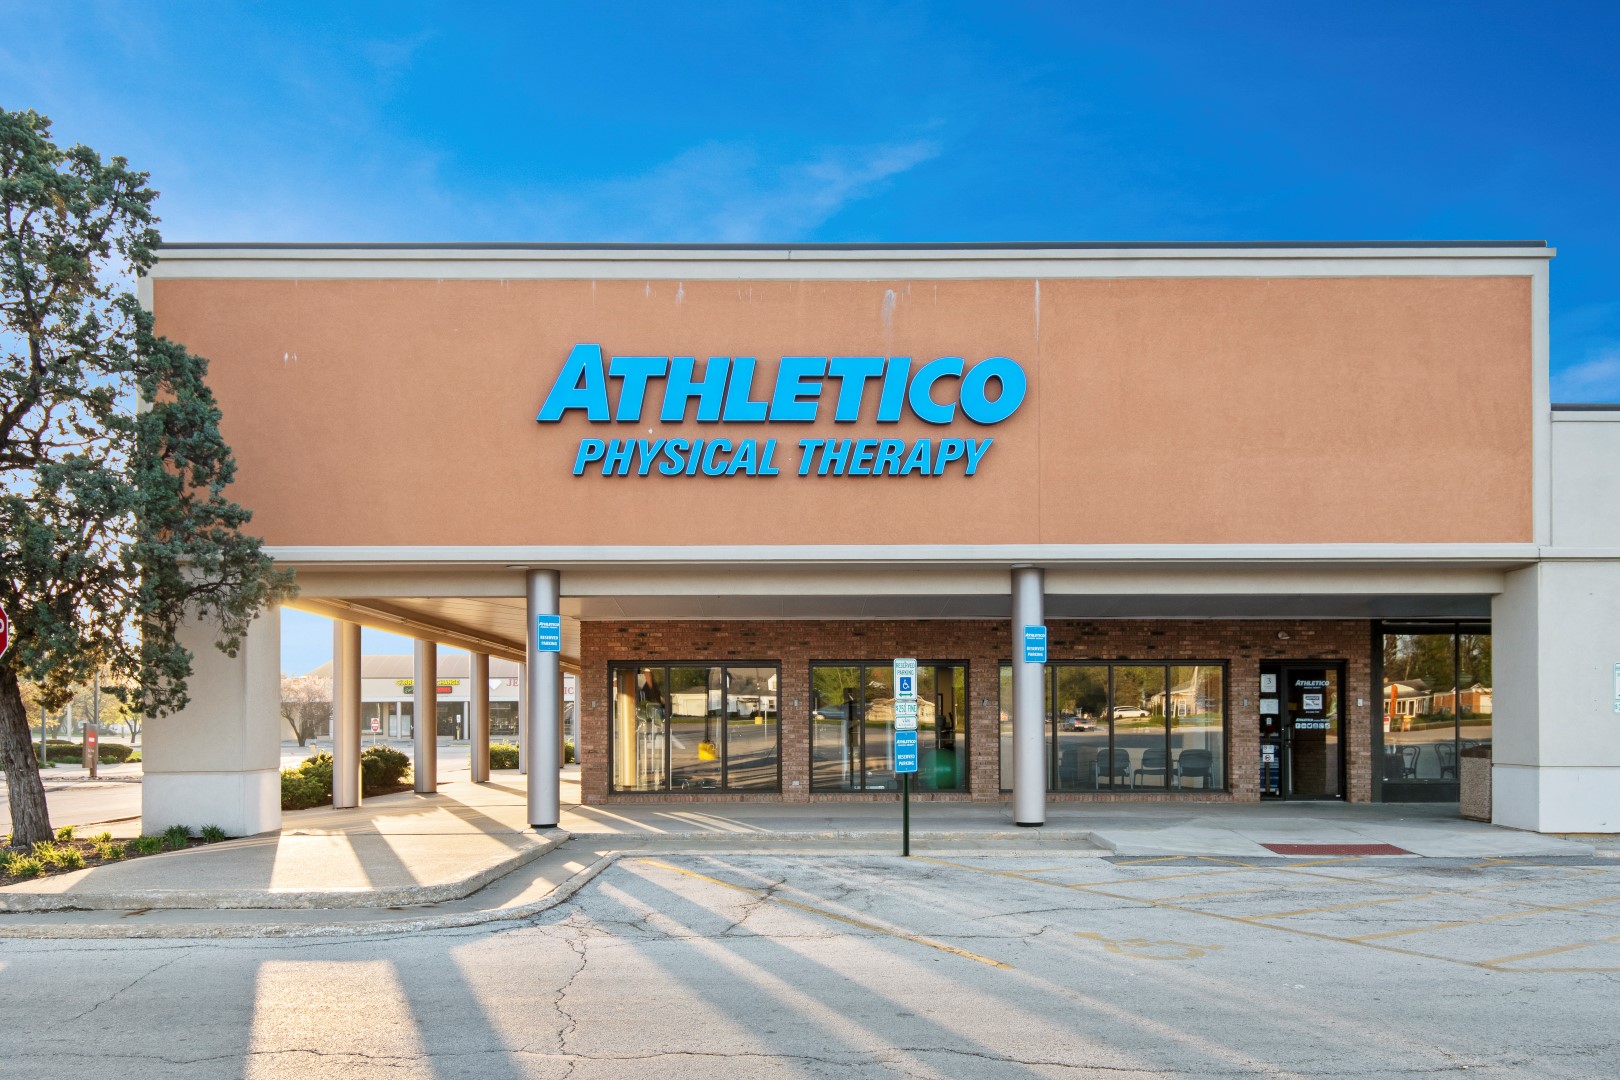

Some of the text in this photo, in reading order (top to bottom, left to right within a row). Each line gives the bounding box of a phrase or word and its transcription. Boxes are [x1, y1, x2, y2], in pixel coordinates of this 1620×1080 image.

[536, 343, 1027, 425] ATHLETICO
[572, 438, 995, 477] PHYSICAL THERAPY
[895, 704, 917, 713] $250 FINE
